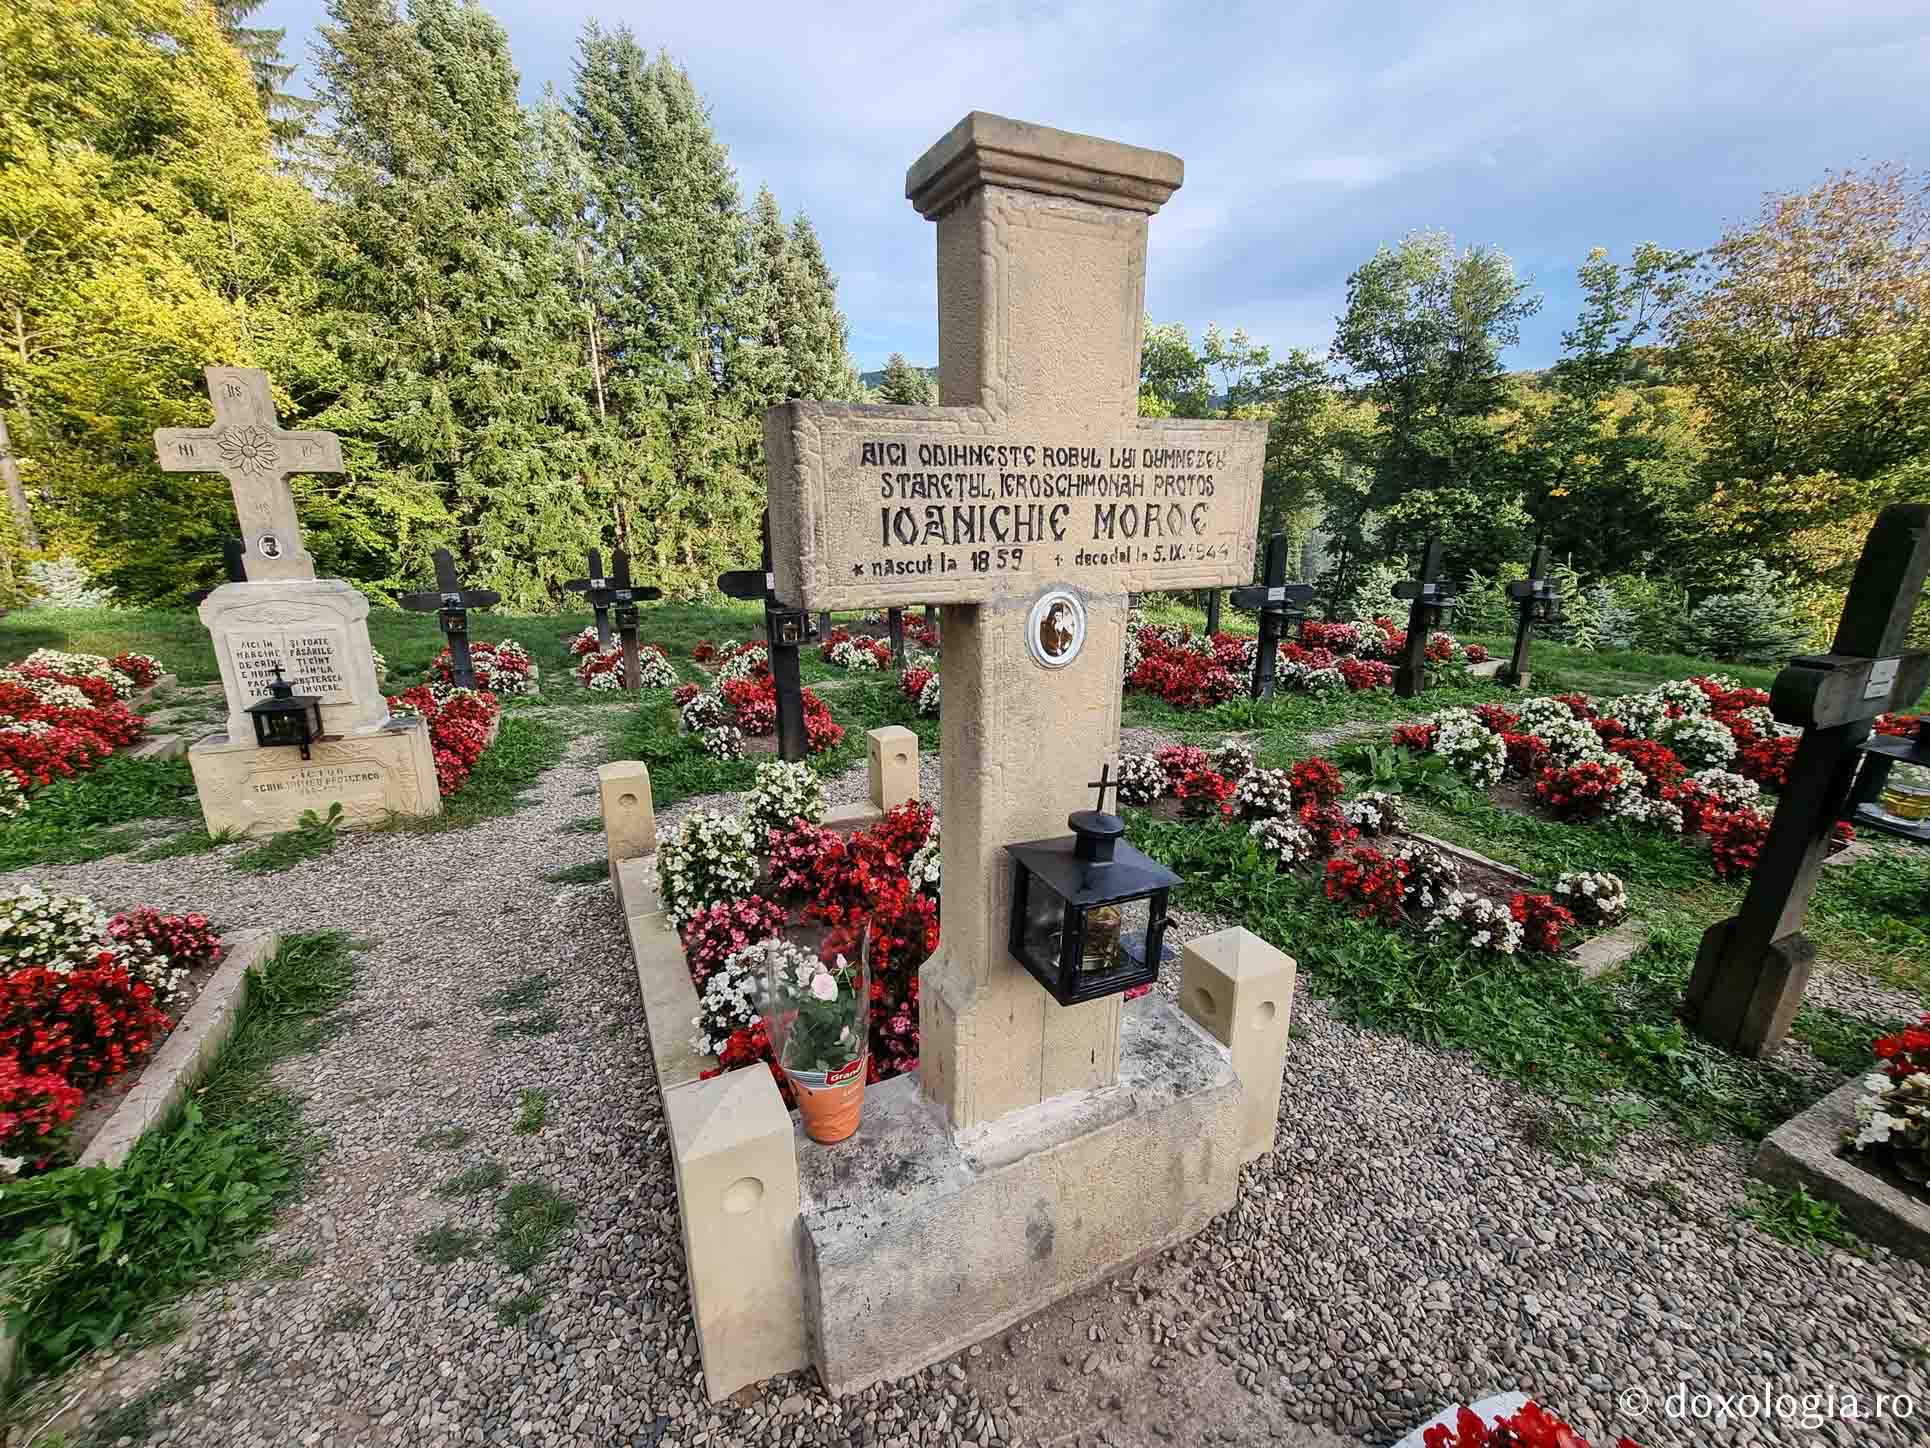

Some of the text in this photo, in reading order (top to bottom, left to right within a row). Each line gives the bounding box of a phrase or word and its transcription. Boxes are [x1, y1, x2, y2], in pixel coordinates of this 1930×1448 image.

[861, 442, 907, 467] AICI
[940, 551, 958, 573] la
[970, 548, 1023, 573] 1859
